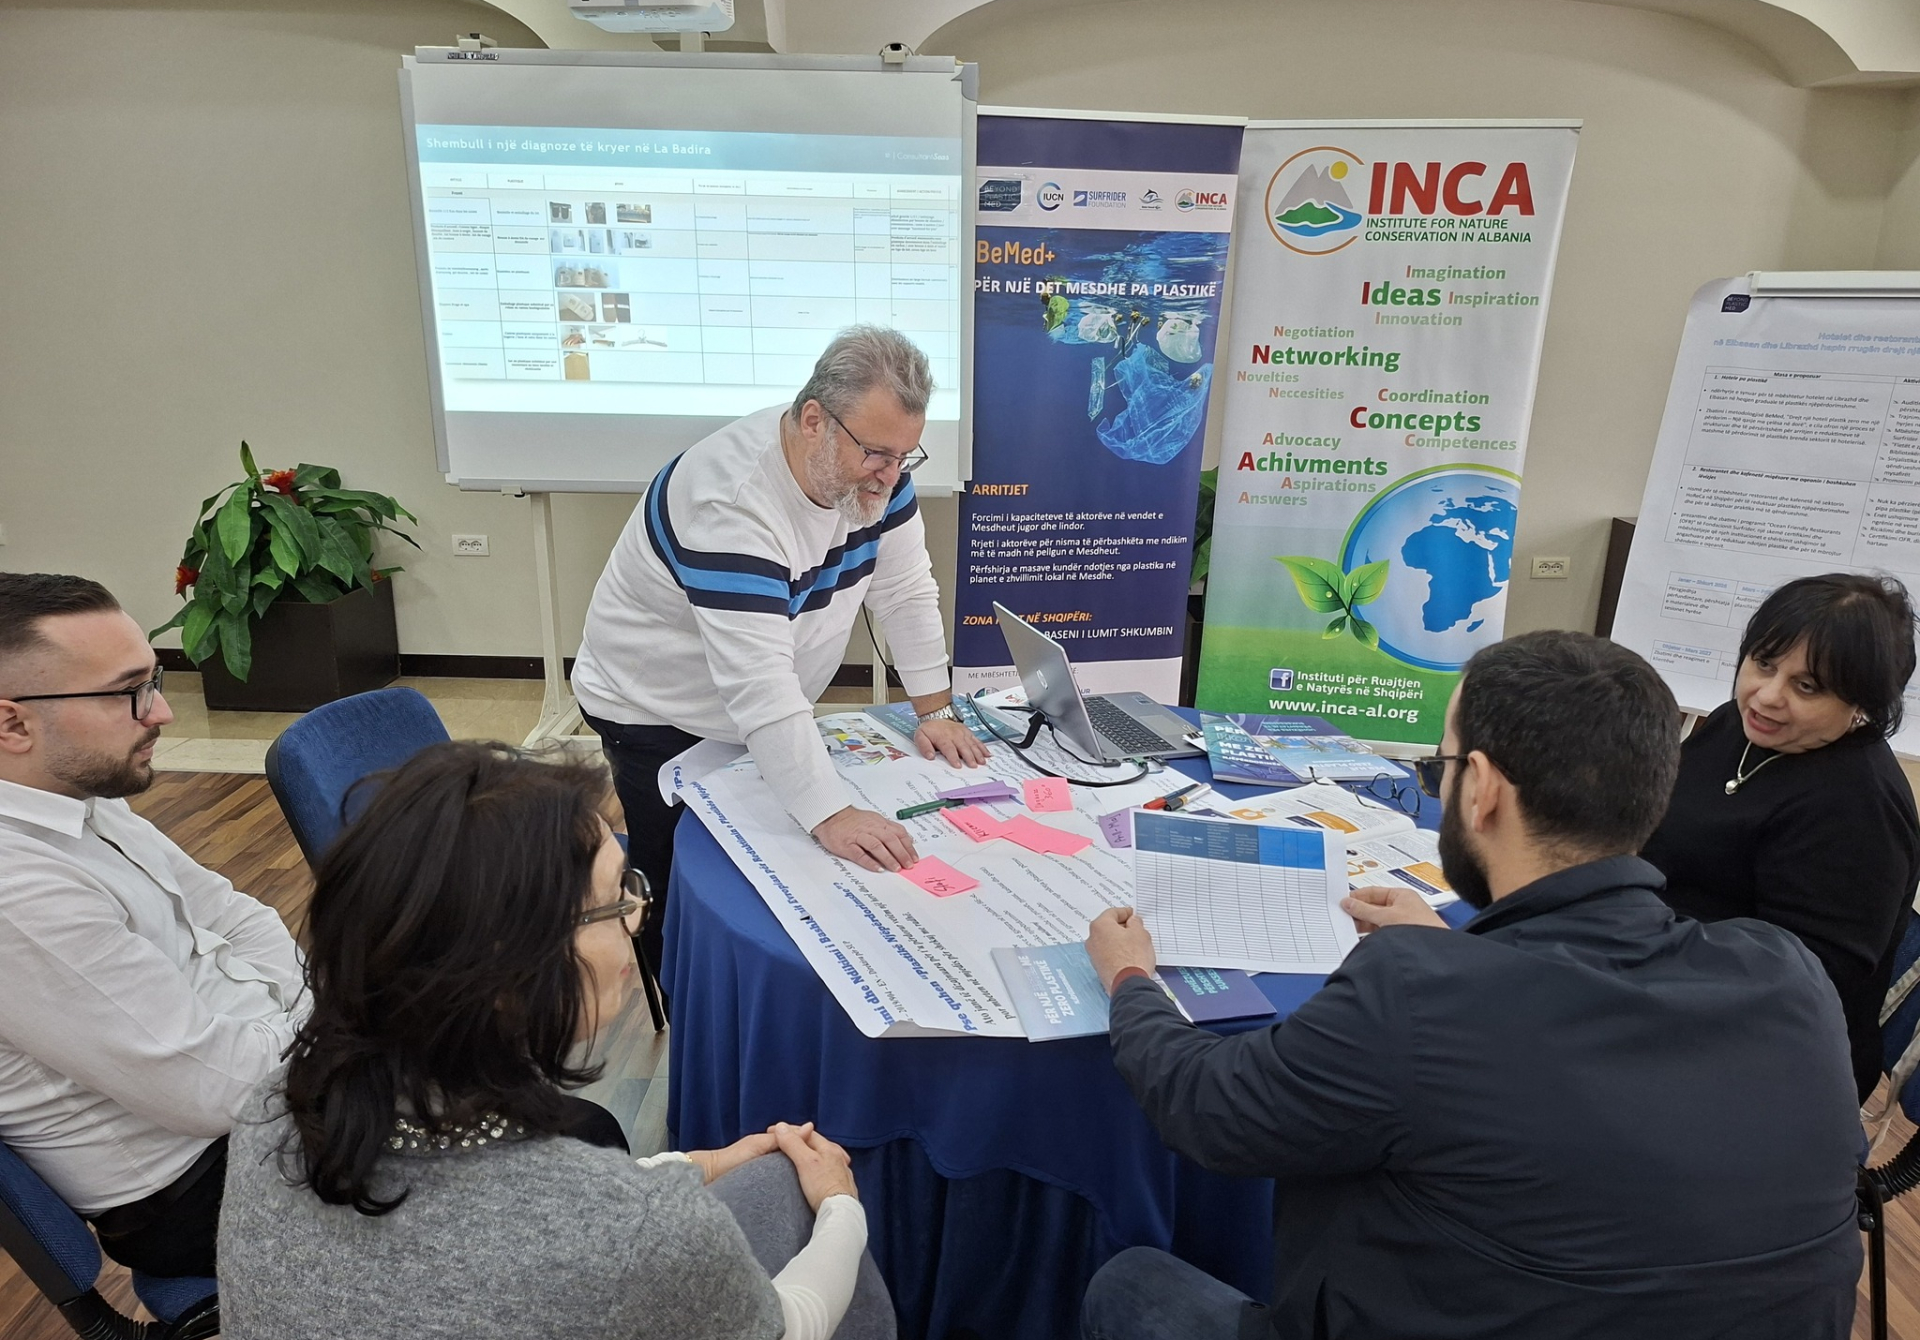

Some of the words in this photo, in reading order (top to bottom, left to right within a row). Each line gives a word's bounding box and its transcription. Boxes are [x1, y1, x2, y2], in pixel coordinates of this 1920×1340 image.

[426, 138, 484, 149] Shembull
[488, 140, 492, 150] i
[497, 140, 517, 153] një
[521, 139, 576, 153] diagnoze
[580, 141, 594, 152] të
[598, 142, 630, 155] kryer
[635, 143, 650, 154] në
[654, 143, 668, 154] La
[672, 144, 711, 155] Badira
[1043, 193, 1064, 202] IUCN
[1088, 190, 1126, 202] SURFRIDER
[1368, 162, 1535, 216] INCA
[1196, 192, 1228, 204] INCA
[1366, 218, 1428, 229] INSTITUTE
[1430, 218, 1456, 229] FOR
[1458, 218, 1508, 230] NATURE
[1365, 231, 1458, 242] CONSERVATION
[1461, 232, 1473, 242] IN
[1477, 232, 1532, 243] ALBANIA
[976, 240, 1055, 265] BeMed+
[1406, 264, 1506, 282] Imagination
[975, 277, 1000, 293] PËR
[1005, 278, 1030, 294] NJË
[1036, 282, 1063, 294] DET
[1066, 282, 1126, 296] MESDHE
[1131, 284, 1149, 296] PA
[1153, 280, 1216, 297] PLASTIKË
[1361, 281, 1441, 306] Ideas
[1448, 291, 1539, 308] Inspiration
[1375, 312, 1463, 326] Innovation
[1274, 325, 1355, 340] Negotiation
[1252, 344, 1400, 373] Networking
[1237, 370, 1299, 384] Novelties
[1269, 387, 1345, 400] Neccesities
[1378, 388, 1490, 405] Coordination
[1350, 406, 1481, 436] Concepts
[1262, 432, 1341, 450] Advocacy
[1404, 434, 1517, 452] Competences
[1237, 452, 1388, 476] Achivments
[972, 484, 1029, 496] ARRITJET
[1281, 476, 1376, 493] Aspirations
[1238, 491, 1308, 506] Answers
[972, 513, 1004, 522] Forcimi
[1011, 512, 1063, 523] kapaciteteve
[1065, 512, 1074, 520] të
[1076, 512, 1112, 520] aktorëve
[1127, 511, 1156, 520] vendet
[972, 523, 1015, 532] Mesdheut
[1017, 523, 1039, 533] jugor
[1041, 523, 1057, 531] dhe
[1059, 522, 1085, 530] lindor.
[971, 540, 994, 549] Rrjeti
[1001, 539, 1037, 547] aktorëve
[1039, 539, 1053, 548] për
[1082, 538, 1090, 546] të
[1093, 537, 1144, 547] përbashkëta
[1161, 536, 1188, 544] ndikim
[1036, 548, 1066, 558] pellgun
[1076, 547, 1121, 555] Mesdheut.
[970, 564, 1010, 574] Përfshirja
[1084, 562, 1114, 572] ndotjes
[1116, 563, 1131, 572] nga
[1133, 561, 1164, 571] plastika
[1166, 561, 1176, 569] në
[970, 575, 996, 584] planet
[1006, 574, 1043, 582] zhvillimit
[1079, 572, 1114, 580] Mesdhe.
[963, 615, 993, 625] ZONA
[1026, 612, 1042, 622] NË
[1043, 611, 1093, 623] SHQIPËRI:
[1044, 630, 1080, 639] BASENI
[1087, 628, 1118, 638] LUMIT
[1120, 626, 1174, 637] SHKUMBIN
[1297, 671, 1344, 684] Instituti
[1347, 675, 1368, 686] për
[1371, 676, 1421, 689] Ruajtjen
[1306, 684, 1352, 695] Natyrës
[1356, 686, 1370, 696] në
[1373, 686, 1423, 700] Shqipëri
[1269, 699, 1419, 723] www.inca-al.org
[1038, 960, 1062, 996] PLASTIKË
[862, 985, 880, 1004] dhe
[930, 981, 962, 1011] quhen
[1034, 990, 1054, 1008] NJË
[1056, 994, 1075, 1017] ZERO
[958, 1013, 978, 1031] Pse
[1044, 1007, 1061, 1024] PËR
